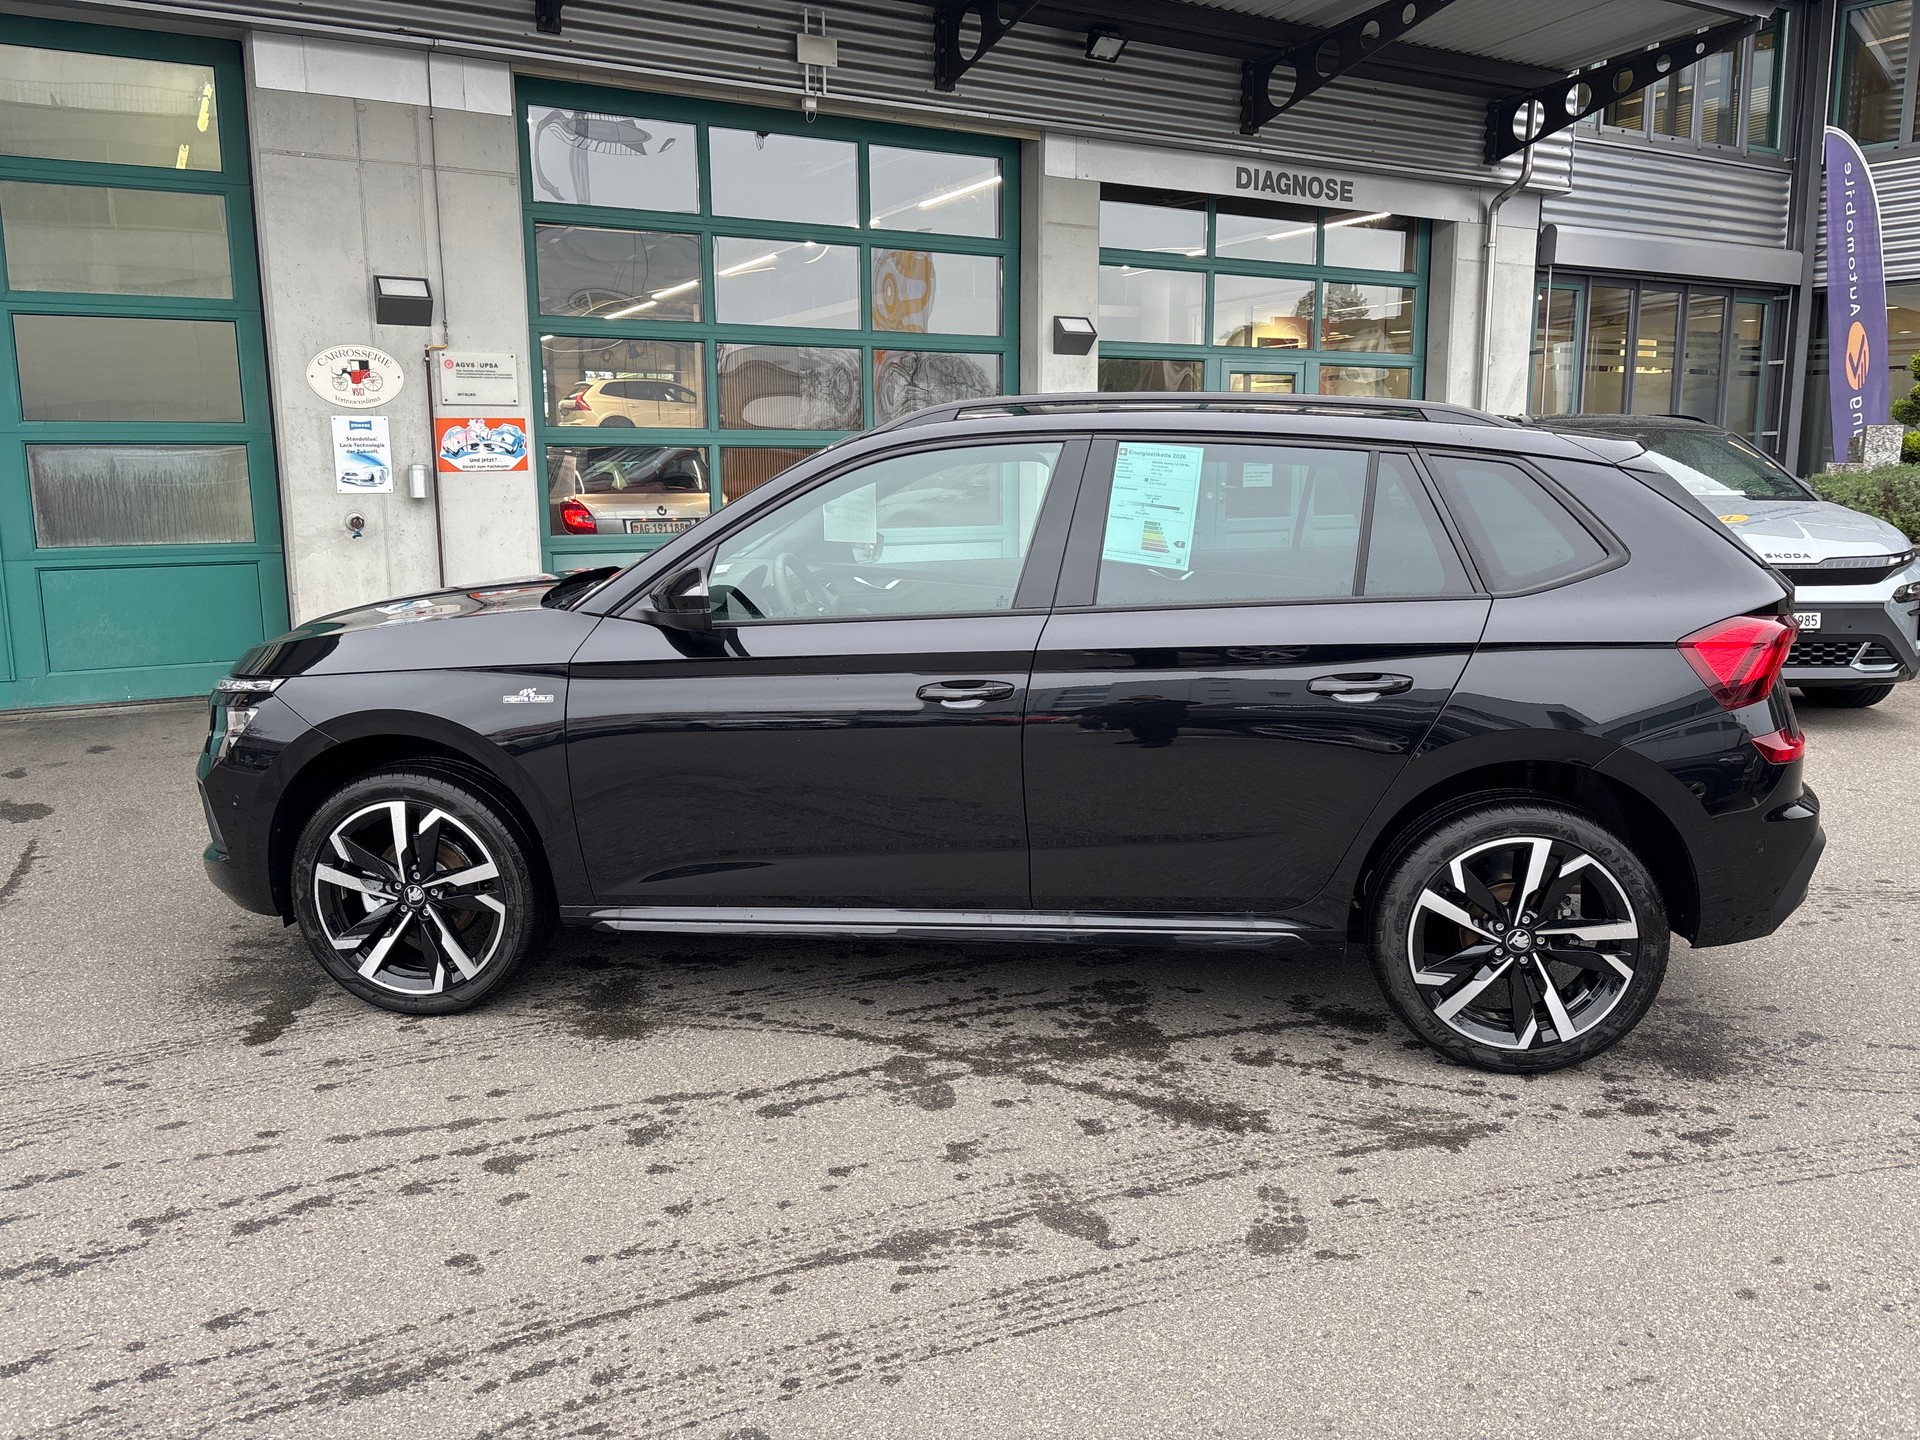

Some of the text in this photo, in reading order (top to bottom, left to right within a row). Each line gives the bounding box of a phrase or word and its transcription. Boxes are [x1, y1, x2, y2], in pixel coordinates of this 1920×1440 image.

[1236, 166, 1354, 202] DIAGNOSE
[317, 349, 393, 368] CARROSSERIE
[351, 387, 365, 396] VSCI
[1793, 614, 1818, 627] 985
